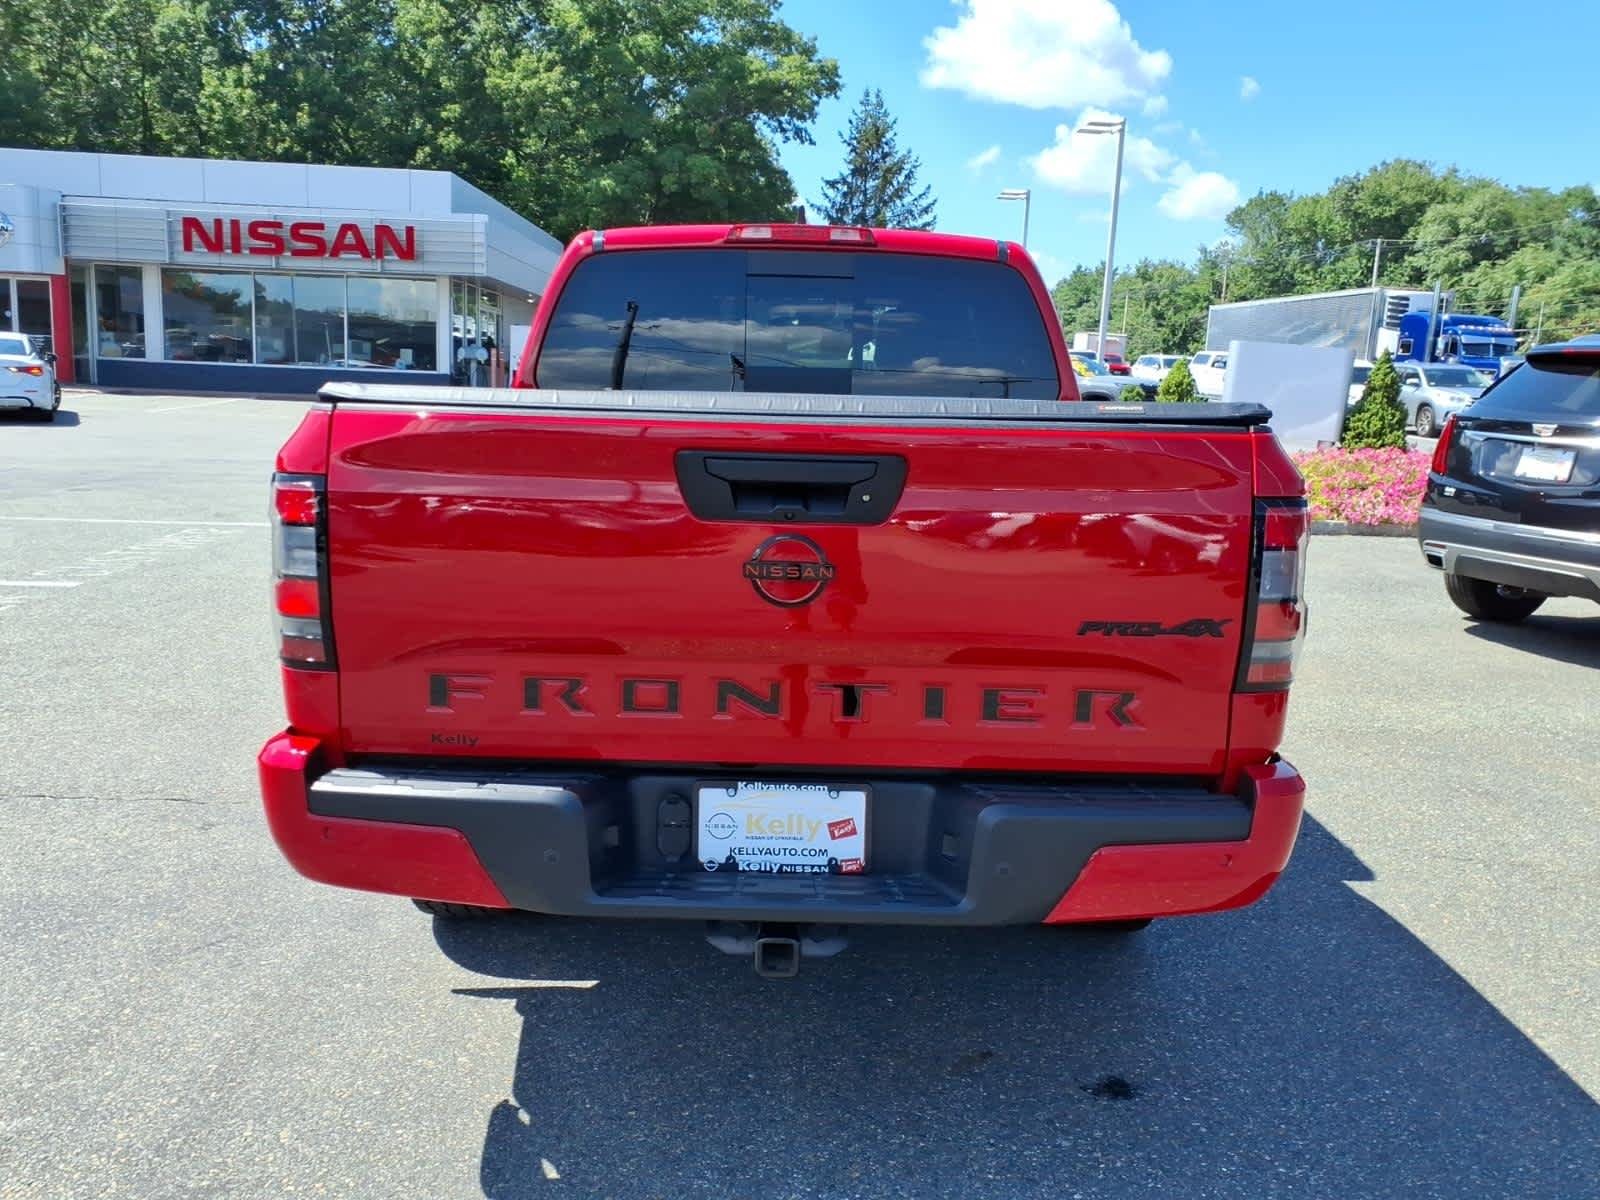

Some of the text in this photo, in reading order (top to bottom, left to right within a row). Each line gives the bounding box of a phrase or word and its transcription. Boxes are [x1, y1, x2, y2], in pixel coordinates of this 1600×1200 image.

[181, 216, 416, 261] NISSAN
[744, 563, 834, 578] NISSAN
[1077, 618, 1232, 638] PRO-4X
[426, 671, 1146, 731] FRONTIER
[430, 732, 480, 748] Kelly
[736, 781, 829, 793] Kellyauto.com
[745, 812, 823, 843] Kelly
[729, 846, 829, 857] KELLYAUTO.COM
[738, 859, 830, 873] Kelly NISSAN
